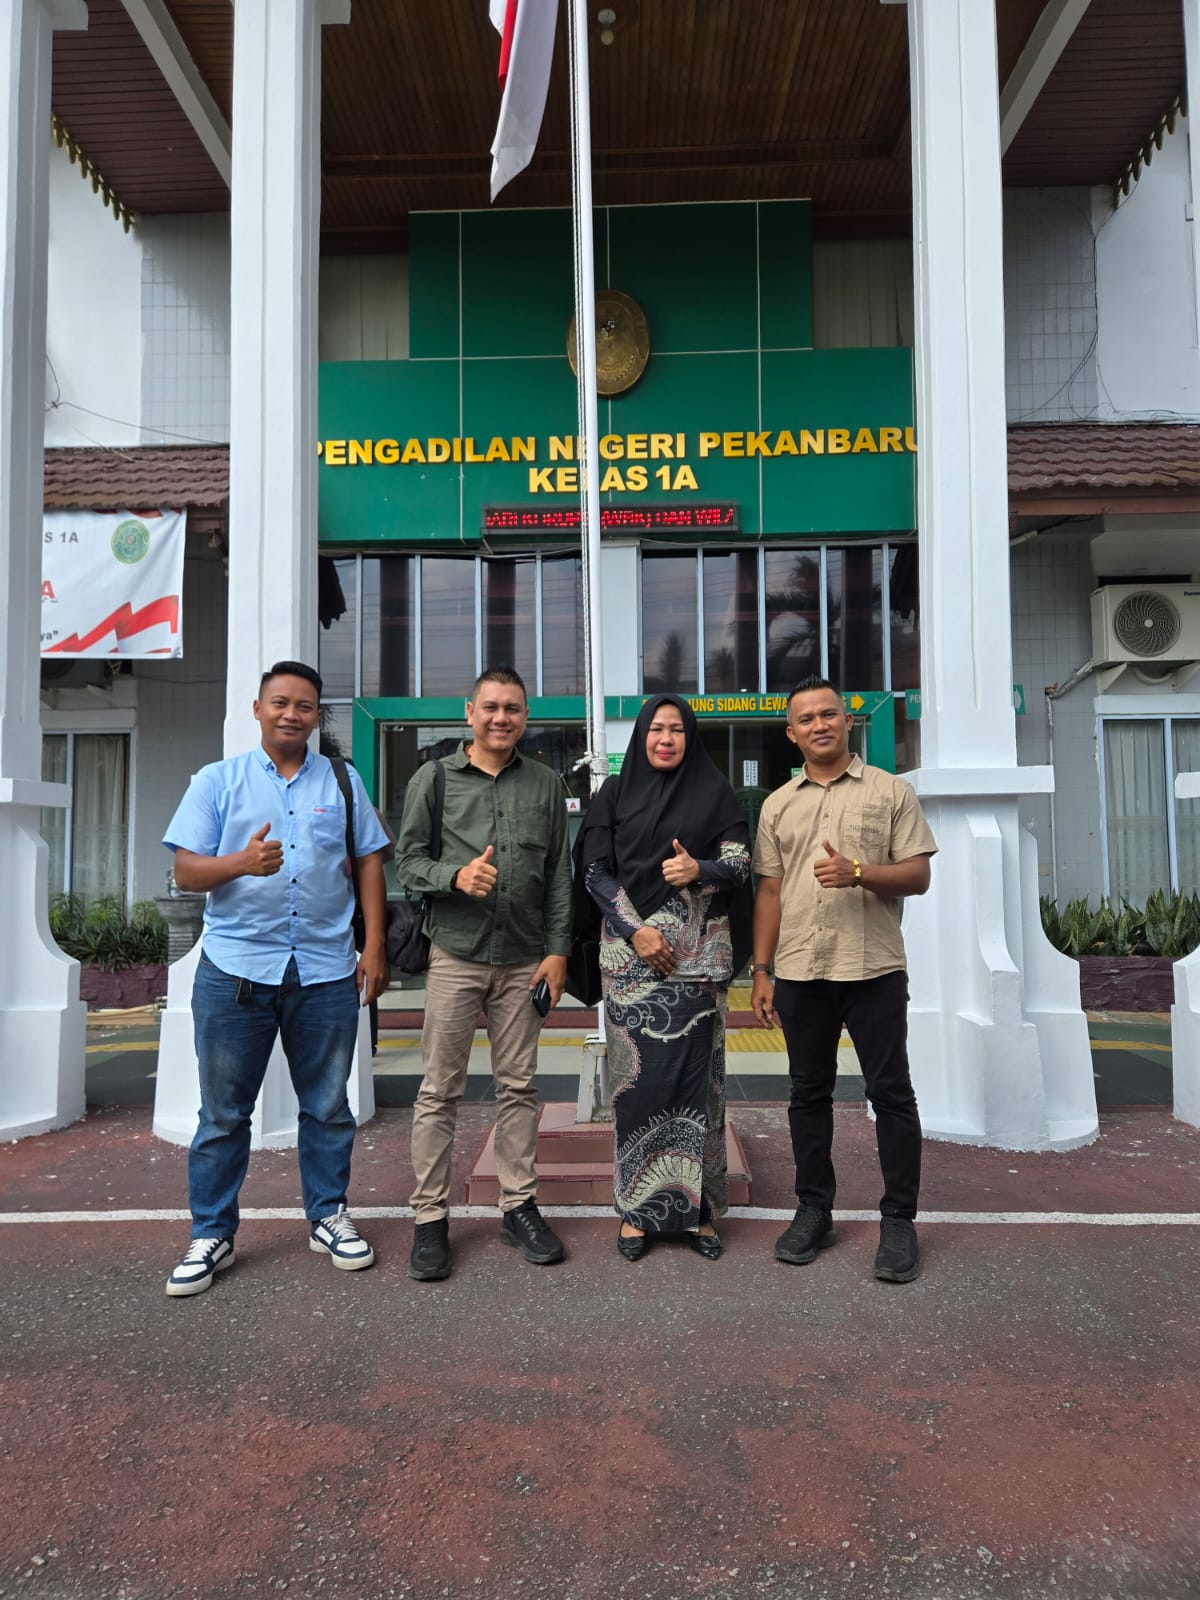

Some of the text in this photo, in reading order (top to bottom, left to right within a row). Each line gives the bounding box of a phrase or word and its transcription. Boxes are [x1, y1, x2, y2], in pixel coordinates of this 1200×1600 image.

[317, 437, 536, 465] ENGADILAN
[655, 464, 700, 491] 1A
[60, 531, 79, 543] 1A
[717, 697, 757, 711] SIDANG
